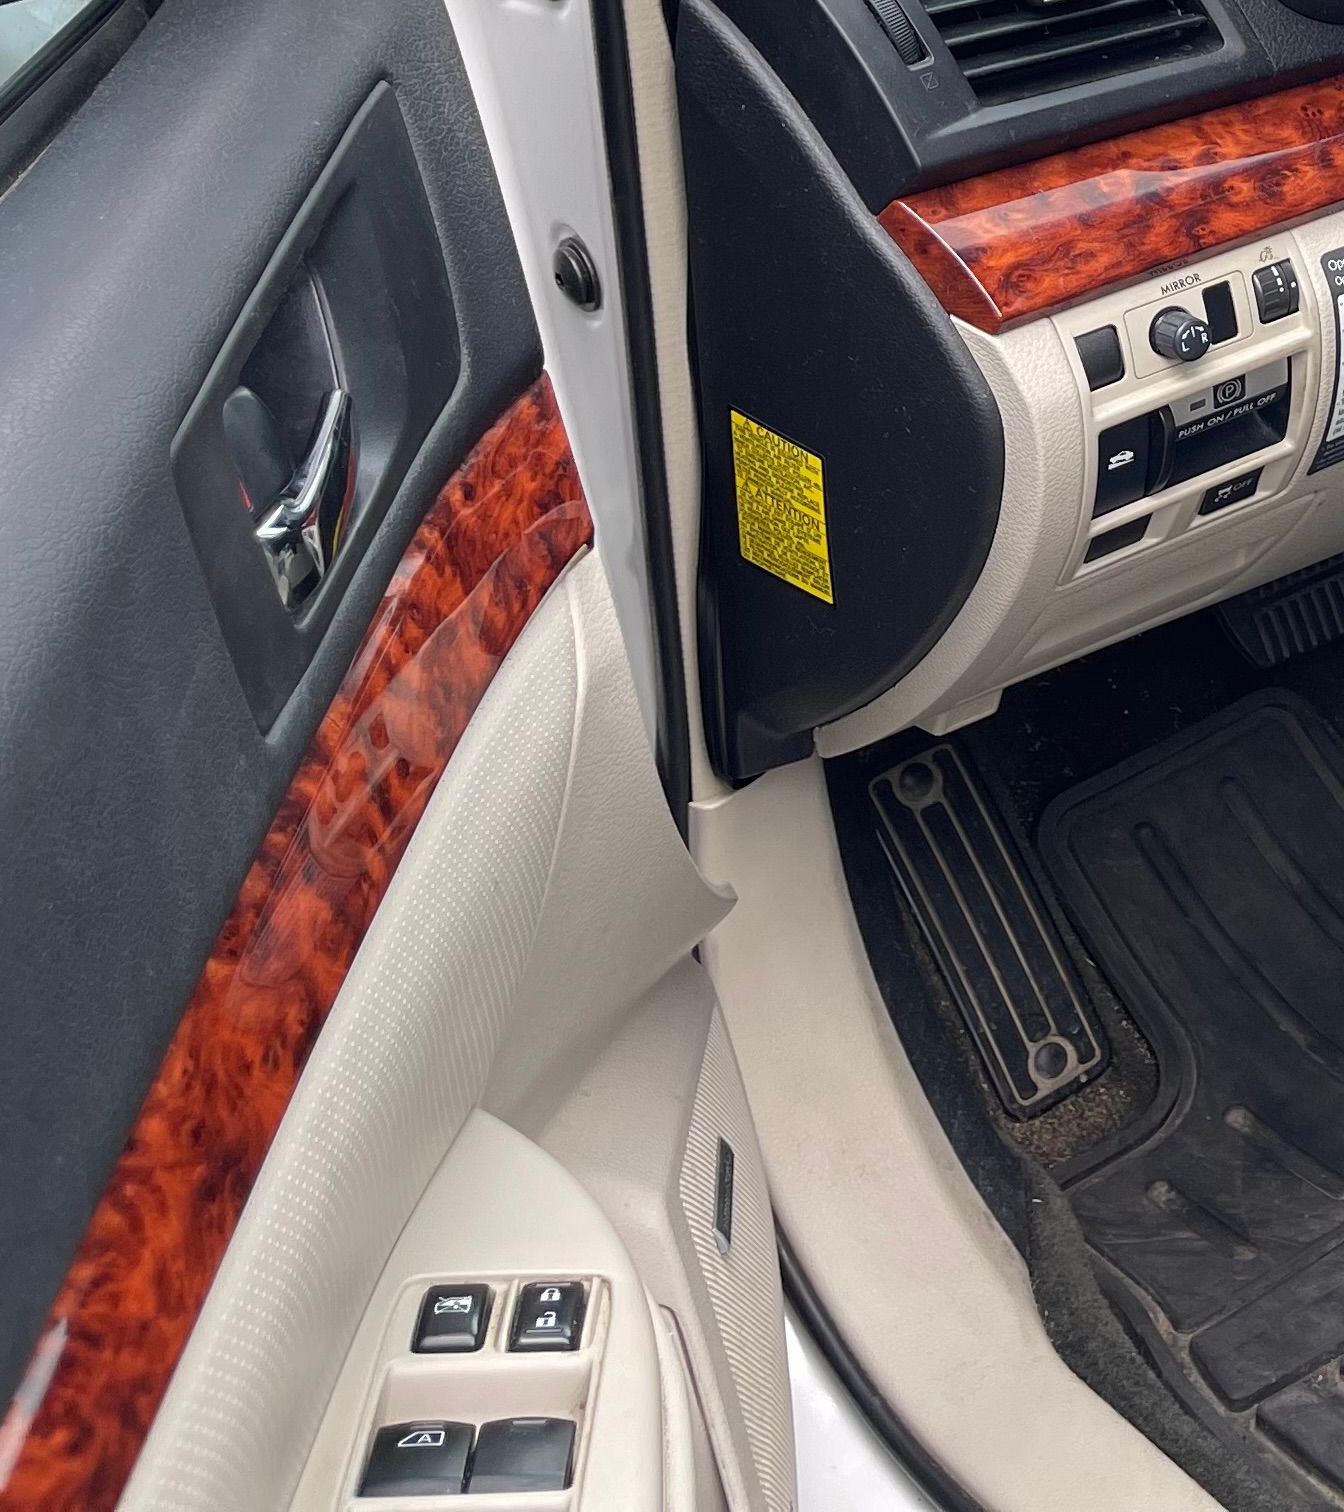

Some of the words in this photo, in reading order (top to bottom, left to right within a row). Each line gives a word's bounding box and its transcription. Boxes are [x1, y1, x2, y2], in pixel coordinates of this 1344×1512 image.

[1160, 272, 1202, 296] MIRROR
[1181, 341, 1190, 353] L
[1200, 332, 1209, 344] R
[1178, 422, 1205, 439] PUSH
[1256, 392, 1277, 407] OFF
[756, 426, 809, 465] CAUTION
[1232, 477, 1254, 492] OFF
[755, 487, 820, 531] ATTENTION
